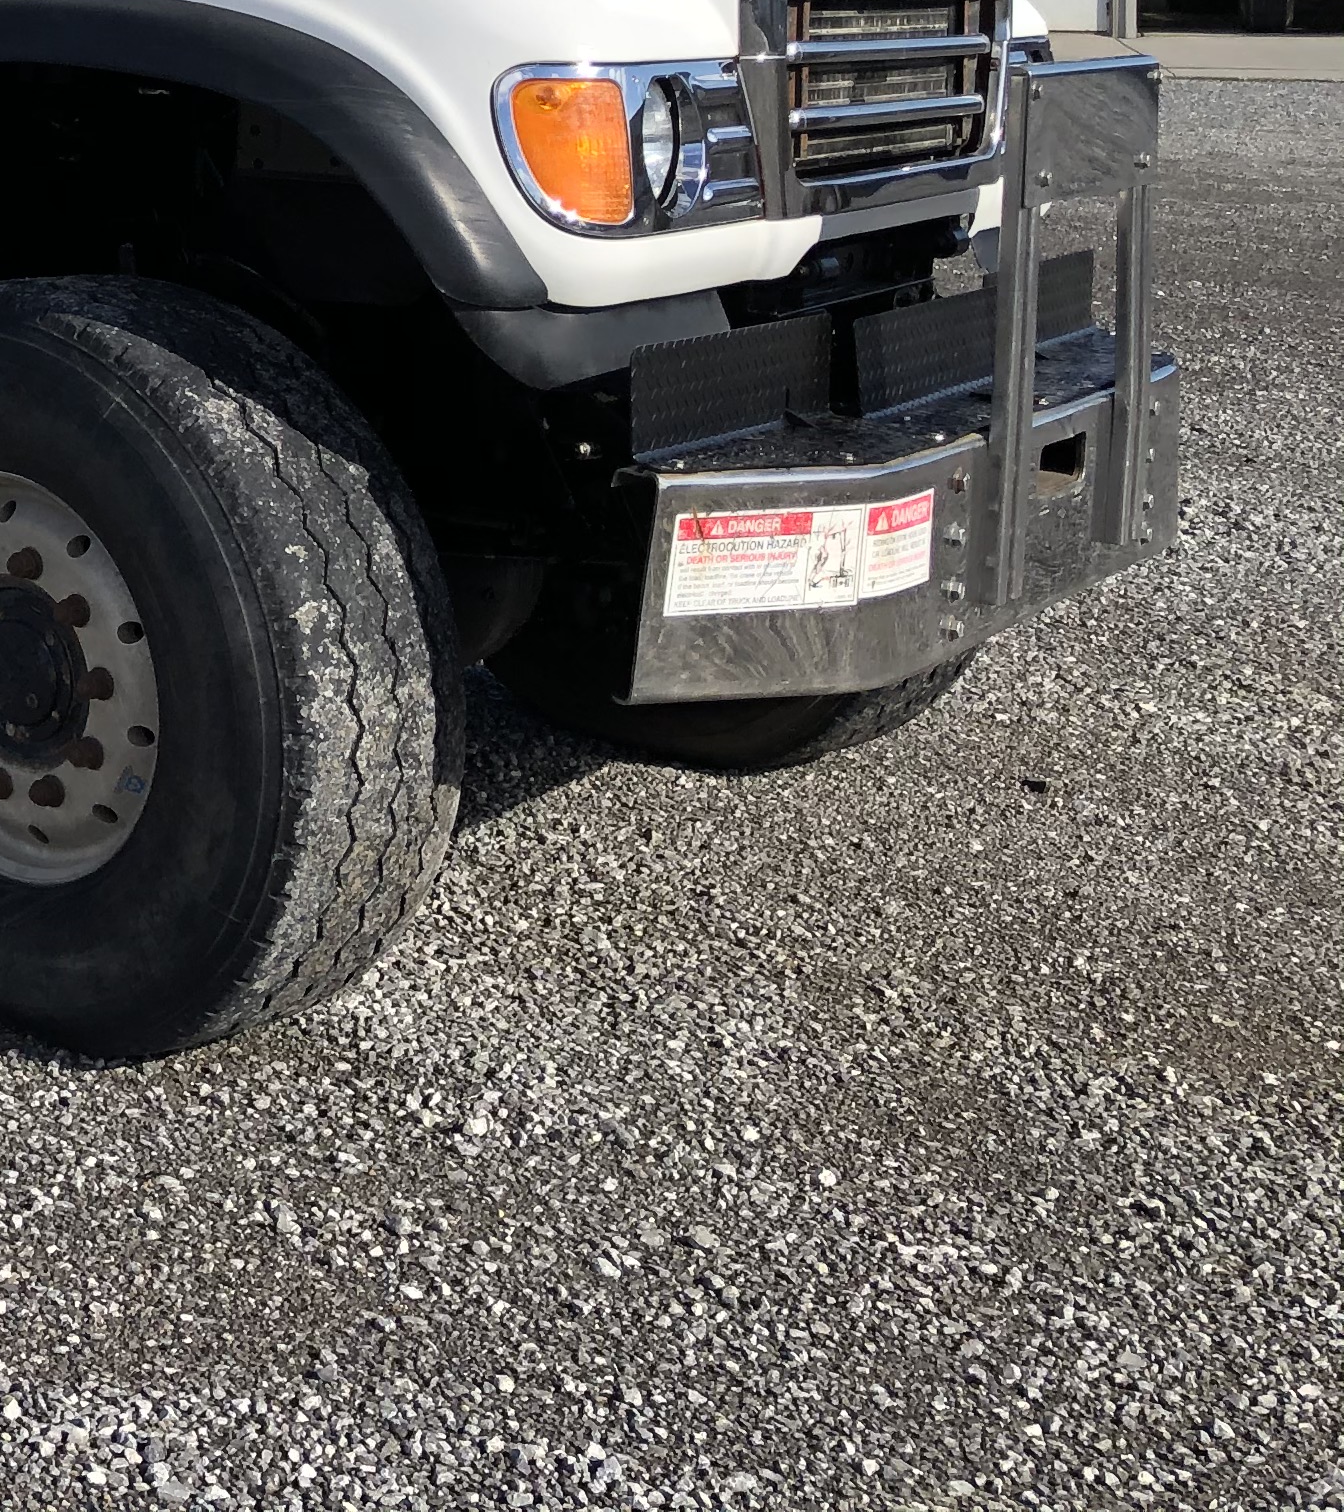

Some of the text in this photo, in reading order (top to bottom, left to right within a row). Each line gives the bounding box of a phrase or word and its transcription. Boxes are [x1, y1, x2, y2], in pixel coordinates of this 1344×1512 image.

[892, 500, 930, 528] DANGER
[727, 518, 782, 534] DANGER
[678, 537, 807, 555] ELECTROCUTION HAZARD
[686, 551, 798, 565] DEATH OR SERIOUS INJURY
